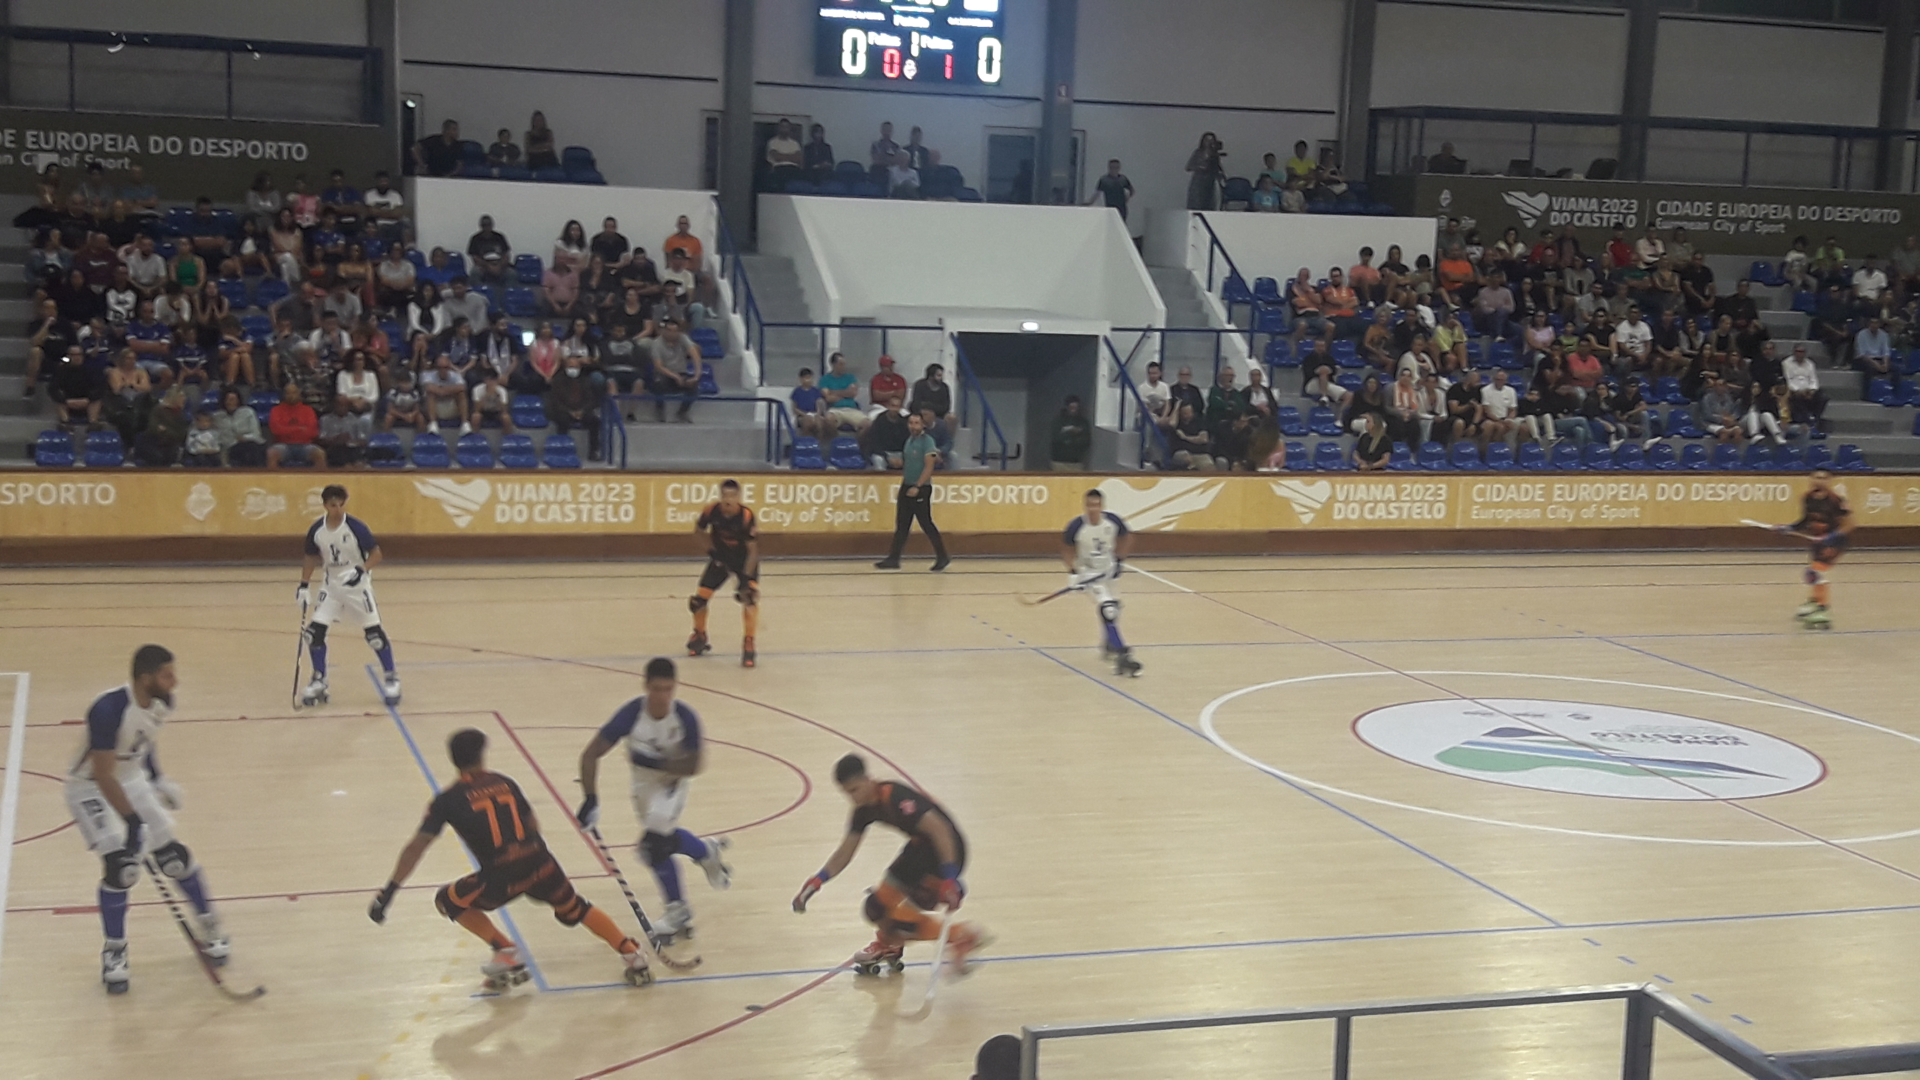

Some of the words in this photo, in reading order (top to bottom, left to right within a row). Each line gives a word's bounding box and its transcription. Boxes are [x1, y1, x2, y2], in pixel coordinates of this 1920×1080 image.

[841, 28, 867, 75] 0
[977, 37, 1002, 83] 0
[883, 48, 900, 78] 0
[944, 54, 953, 79] 1
[25, 130, 141, 154] EUROPEIA
[148, 135, 182, 156] DO
[189, 137, 308, 162] DESPORTO
[1551, 196, 1599, 212] VIANA
[1601, 198, 1638, 214] 2023
[1656, 200, 1713, 217] CIDADE
[1718, 202, 1793, 219] EUROPEIA
[1797, 205, 1820, 221] DO
[1823, 206, 1901, 225] DESPORTO
[1550, 211, 1571, 226] DO
[496, 482, 574, 502] VIANA
[577, 482, 636, 502] 2023
[665, 483, 756, 504] CIDAE
[764, 483, 880, 505] EUROPEIA
[930, 484, 1049, 505] DESPORTO
[1334, 483, 1397, 501] VIANA
[1401, 483, 1448, 501] 2023
[1471, 483, 1546, 503] CIDADE
[1552, 483, 1649, 502] EUROPEIA
[1655, 483, 1686, 501] DO
[1690, 483, 1792, 502] DESPORTO
[494, 503, 530, 524] DO
[532, 503, 636, 524] CASTELO
[758, 507, 793, 527] City
[800, 506, 818, 523] of
[823, 507, 870, 526] Sport
[1332, 502, 1361, 520] DO
[1362, 502, 1447, 520] CASTELO
[1471, 505, 1541, 522] European
[1546, 504, 1576, 522] City
[1580, 504, 1597, 519] of
[1600, 504, 1641, 521] Sport
[470, 794, 526, 848] 77
